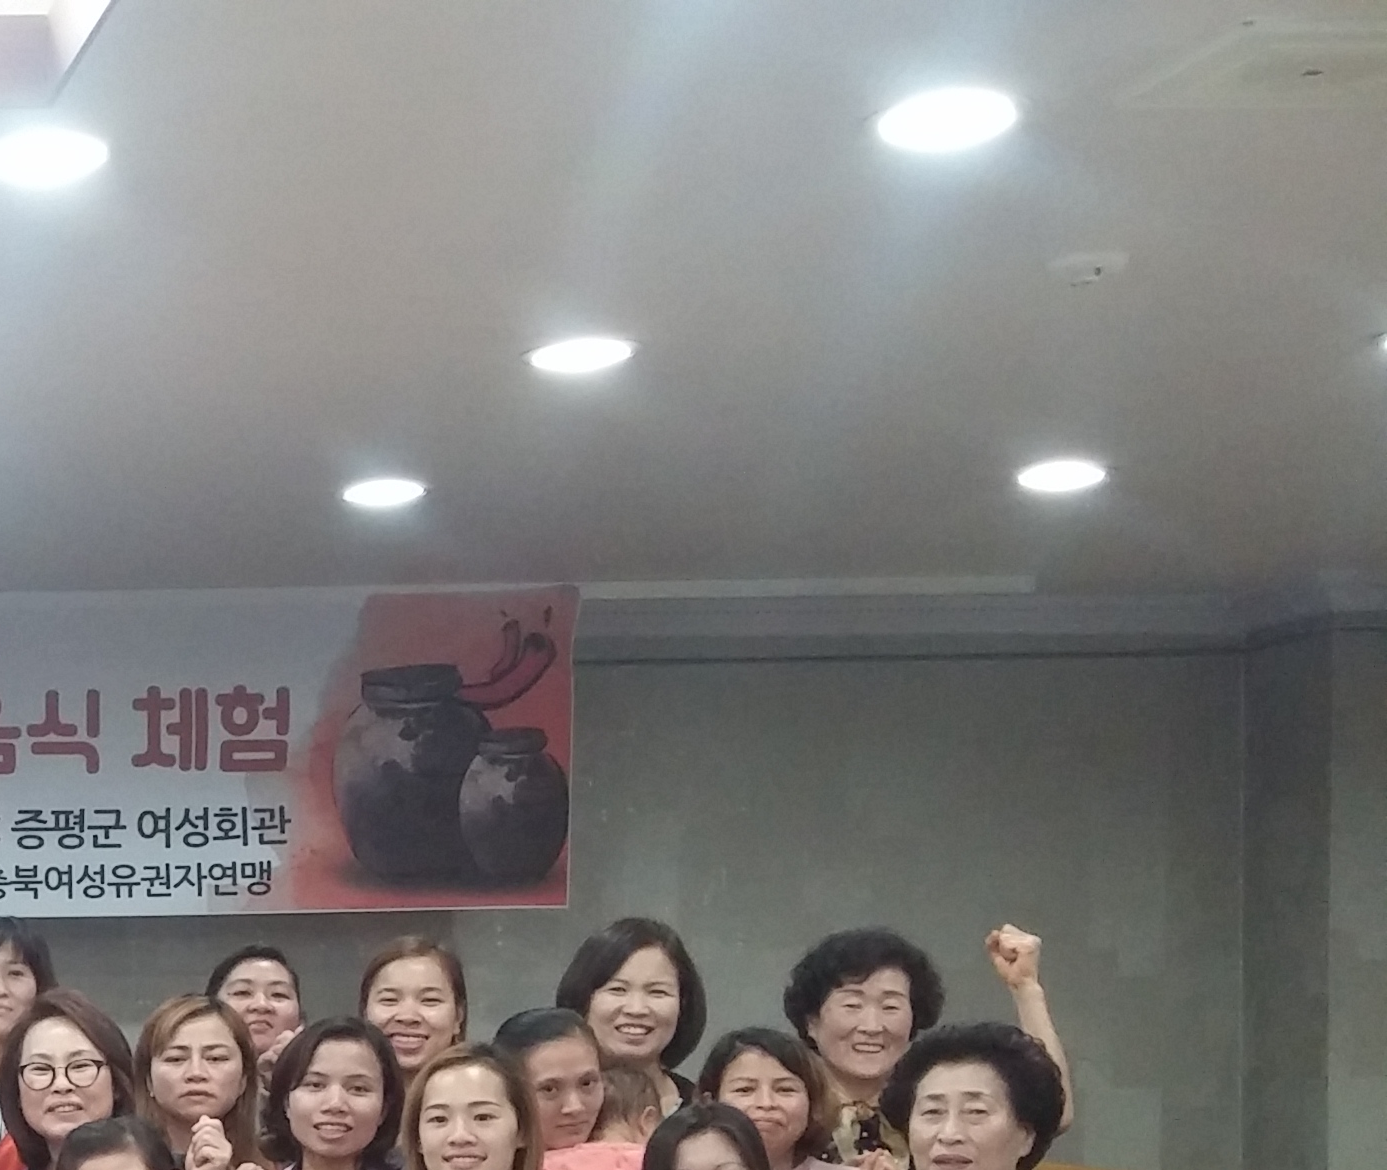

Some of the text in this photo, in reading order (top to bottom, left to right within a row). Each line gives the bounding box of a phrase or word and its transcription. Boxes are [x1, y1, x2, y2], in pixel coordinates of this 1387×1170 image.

[131, 684, 291, 773] 체험
[10, 807, 127, 850] 증평군
[136, 804, 292, 849] 여성회관
